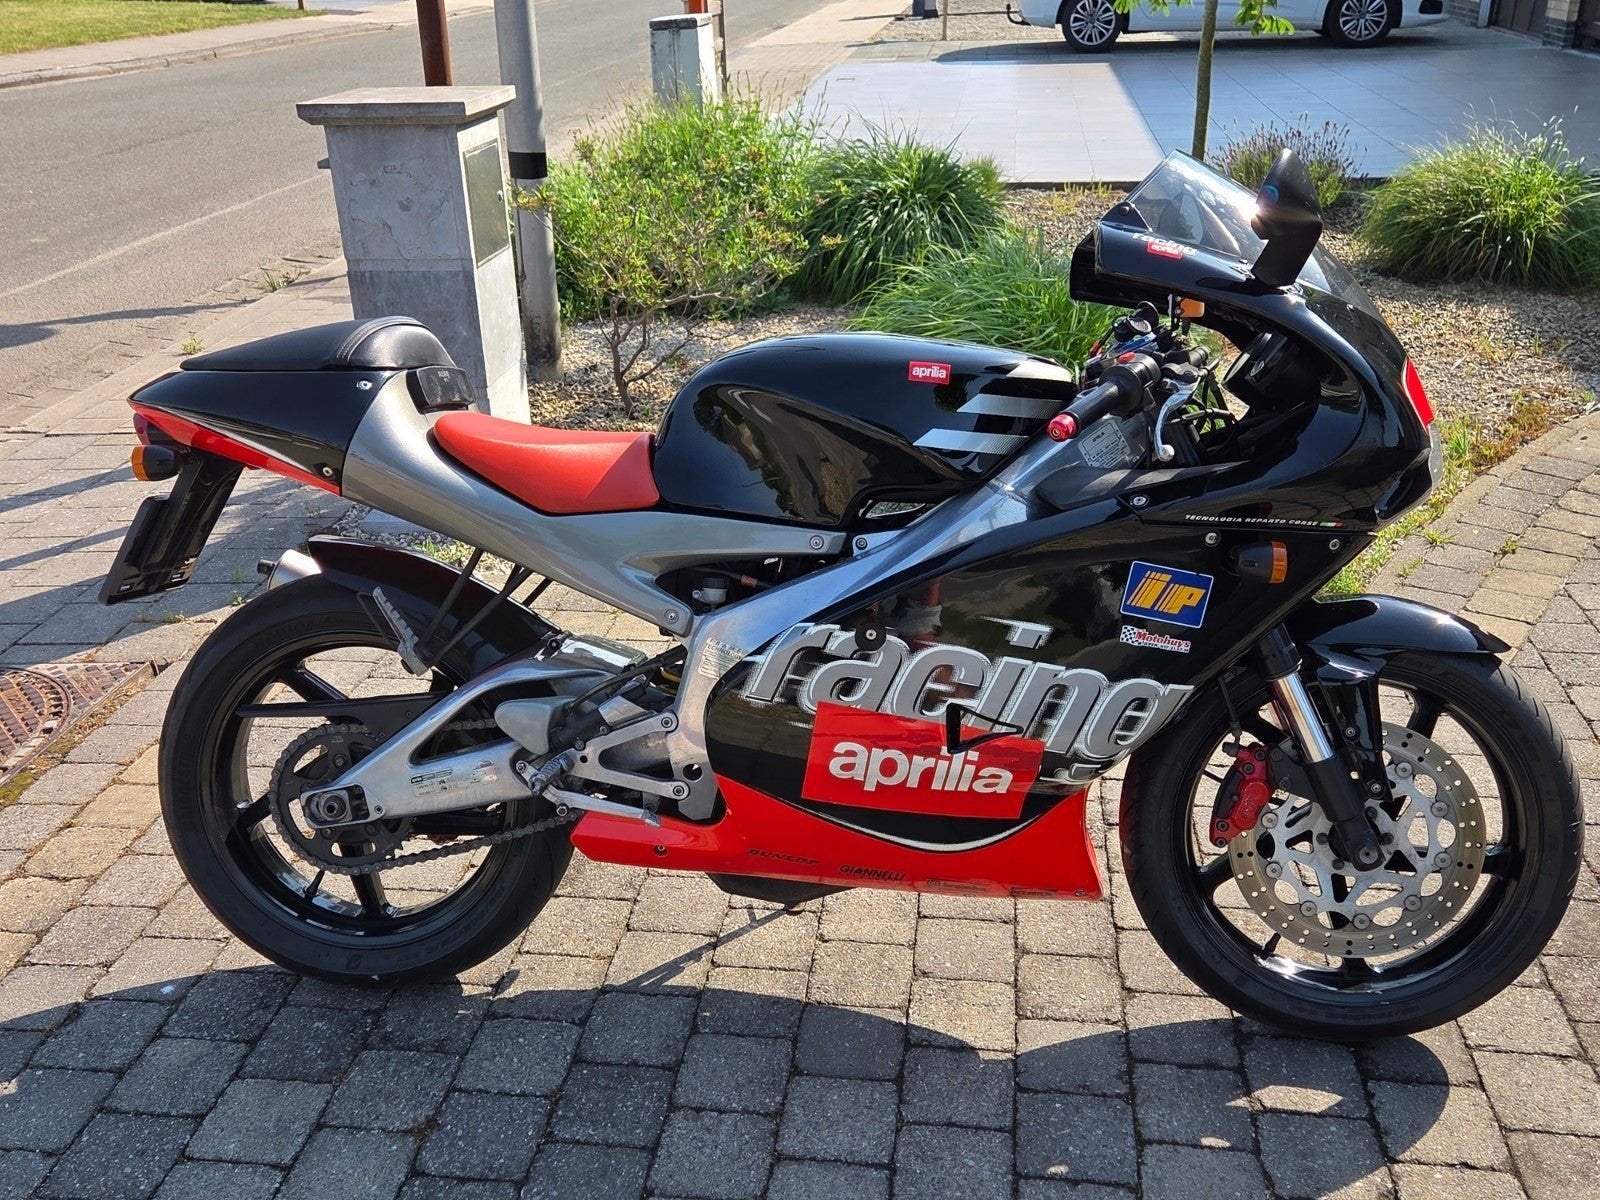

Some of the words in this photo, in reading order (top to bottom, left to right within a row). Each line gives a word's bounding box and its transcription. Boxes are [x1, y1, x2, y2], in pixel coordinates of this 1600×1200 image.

[1132, 232, 1199, 256] racing
[912, 366, 947, 378] aprilia
[1135, 631, 1191, 649] Motohuys
[741, 616, 1196, 783] racing
[828, 741, 1014, 794] aprilia
[747, 848, 820, 866] DUNLOP
[839, 864, 906, 882] GIANNELLI
